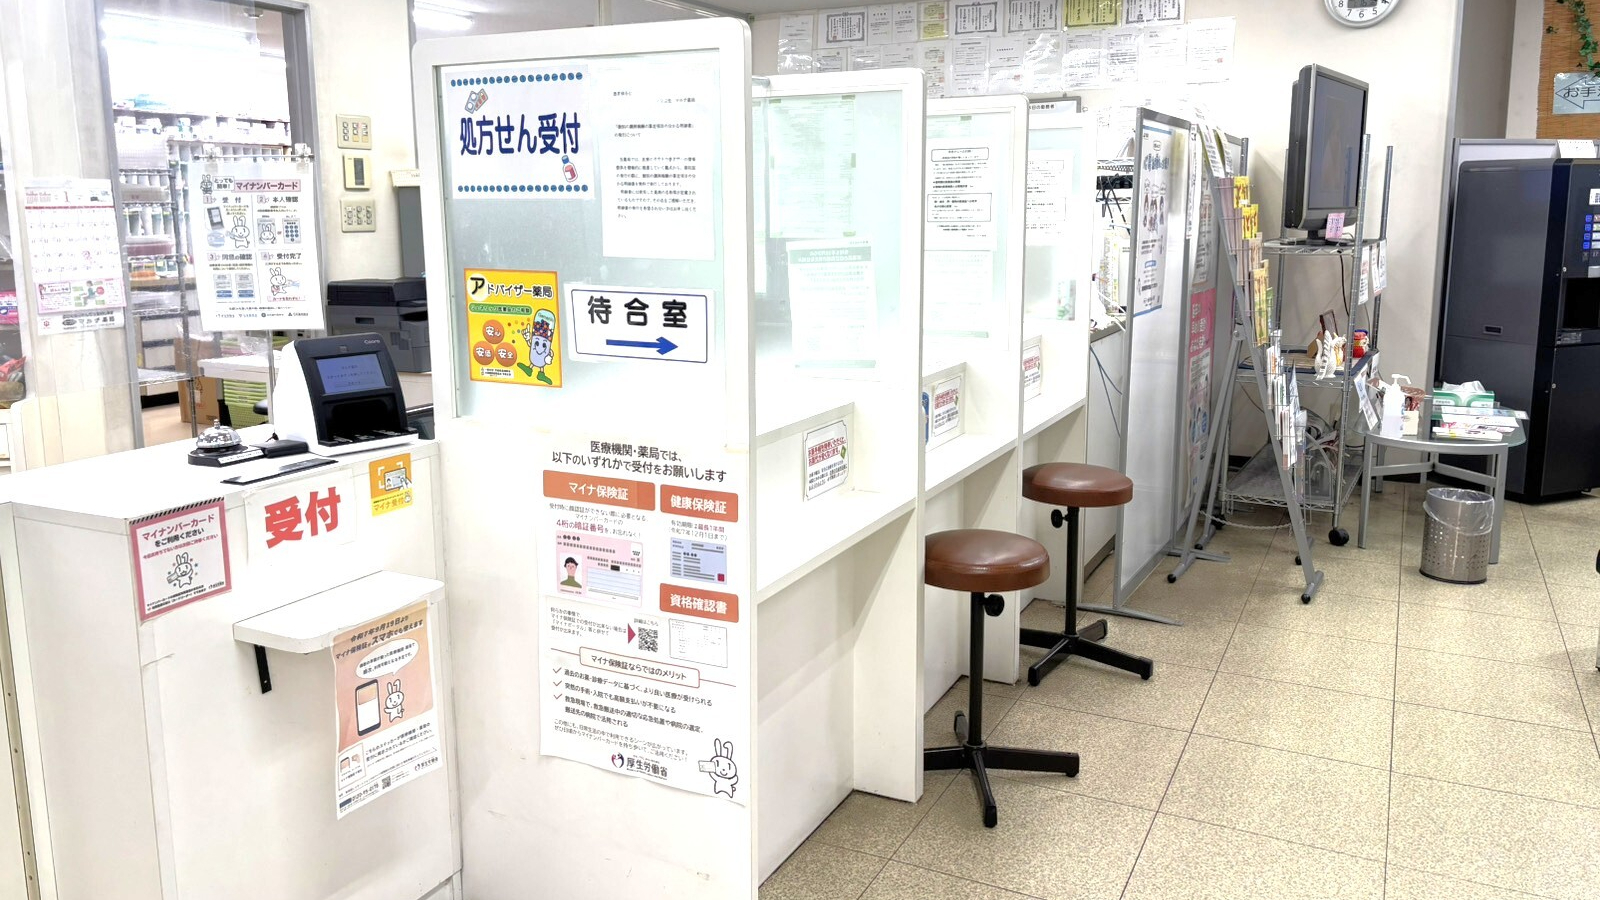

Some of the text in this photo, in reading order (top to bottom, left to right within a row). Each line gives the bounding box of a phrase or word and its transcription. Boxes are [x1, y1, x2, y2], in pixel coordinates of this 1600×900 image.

[1563, 85, 1600, 98] お手
[460, 112, 580, 156] 処方せん受付
[236, 182, 298, 190] マイナンバーカード
[470, 277, 553, 298] アドバイザー薬局
[588, 295, 688, 329] 待合室
[485, 325, 501, 337] 安心
[498, 348, 514, 359] 安全
[591, 441, 682, 462] 医療機関・薬局では、
[552, 451, 727, 482] 以下のいずれかで受付をお願いします
[568, 482, 629, 501] マイナ保険証
[670, 495, 727, 514] 健康保険証
[142, 514, 214, 541] マイナンバーカード
[265, 486, 341, 549] 受付
[155, 528, 204, 547] をご利用ください
[670, 594, 727, 614] 資格確認書
[350, 616, 409, 643] 令和7年9月19日より
[591, 655, 686, 680] マイナ保険証ならではのメリット
[626, 758, 667, 778] 厚生労働省
